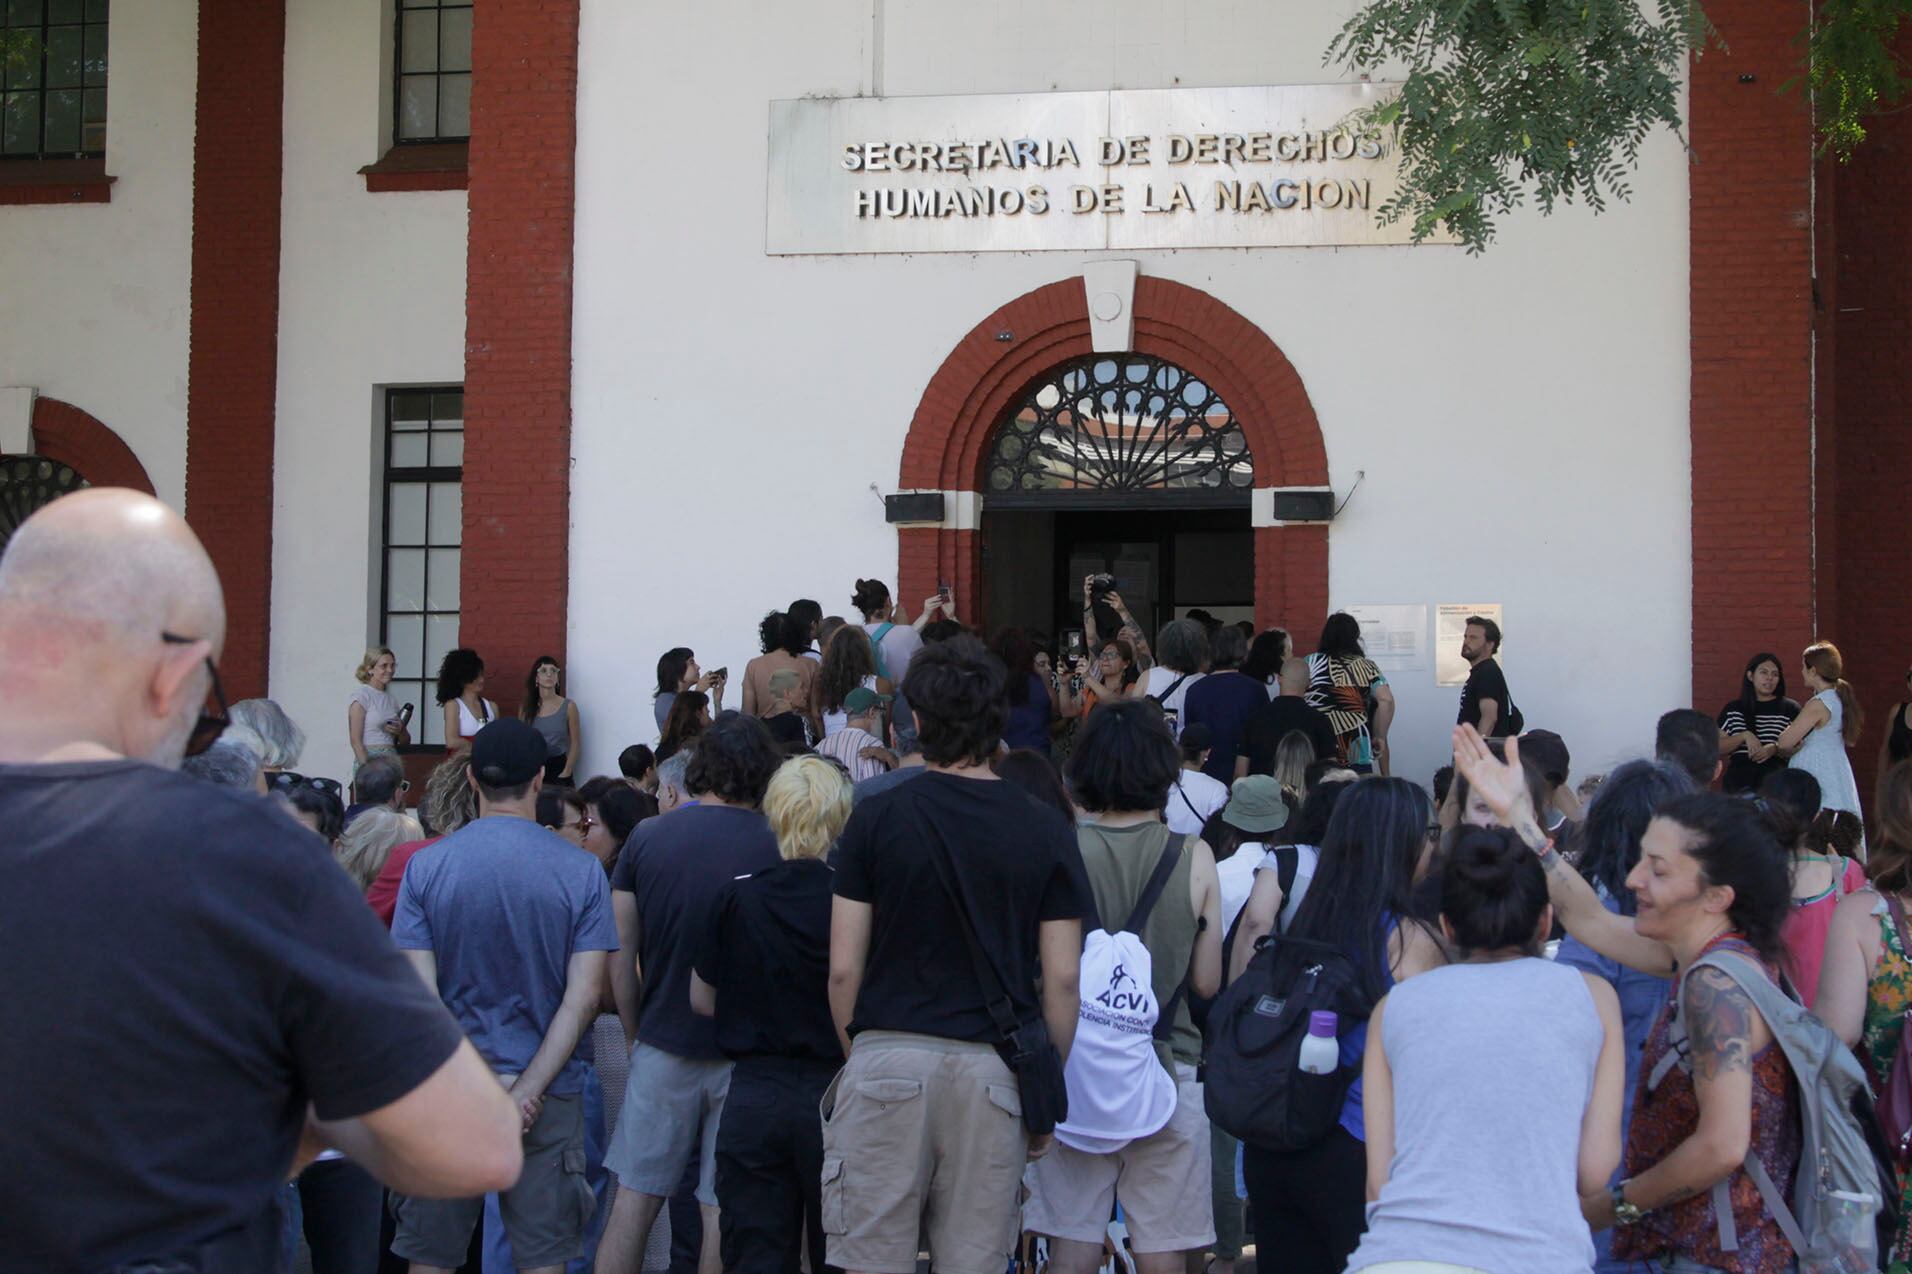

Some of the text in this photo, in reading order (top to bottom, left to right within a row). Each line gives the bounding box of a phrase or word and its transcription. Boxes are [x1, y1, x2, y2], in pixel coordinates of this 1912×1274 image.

[840, 129, 1383, 171] SECRETARIA DE DERECHOS
[854, 177, 1371, 218] HUMANOS DE LA NACION
